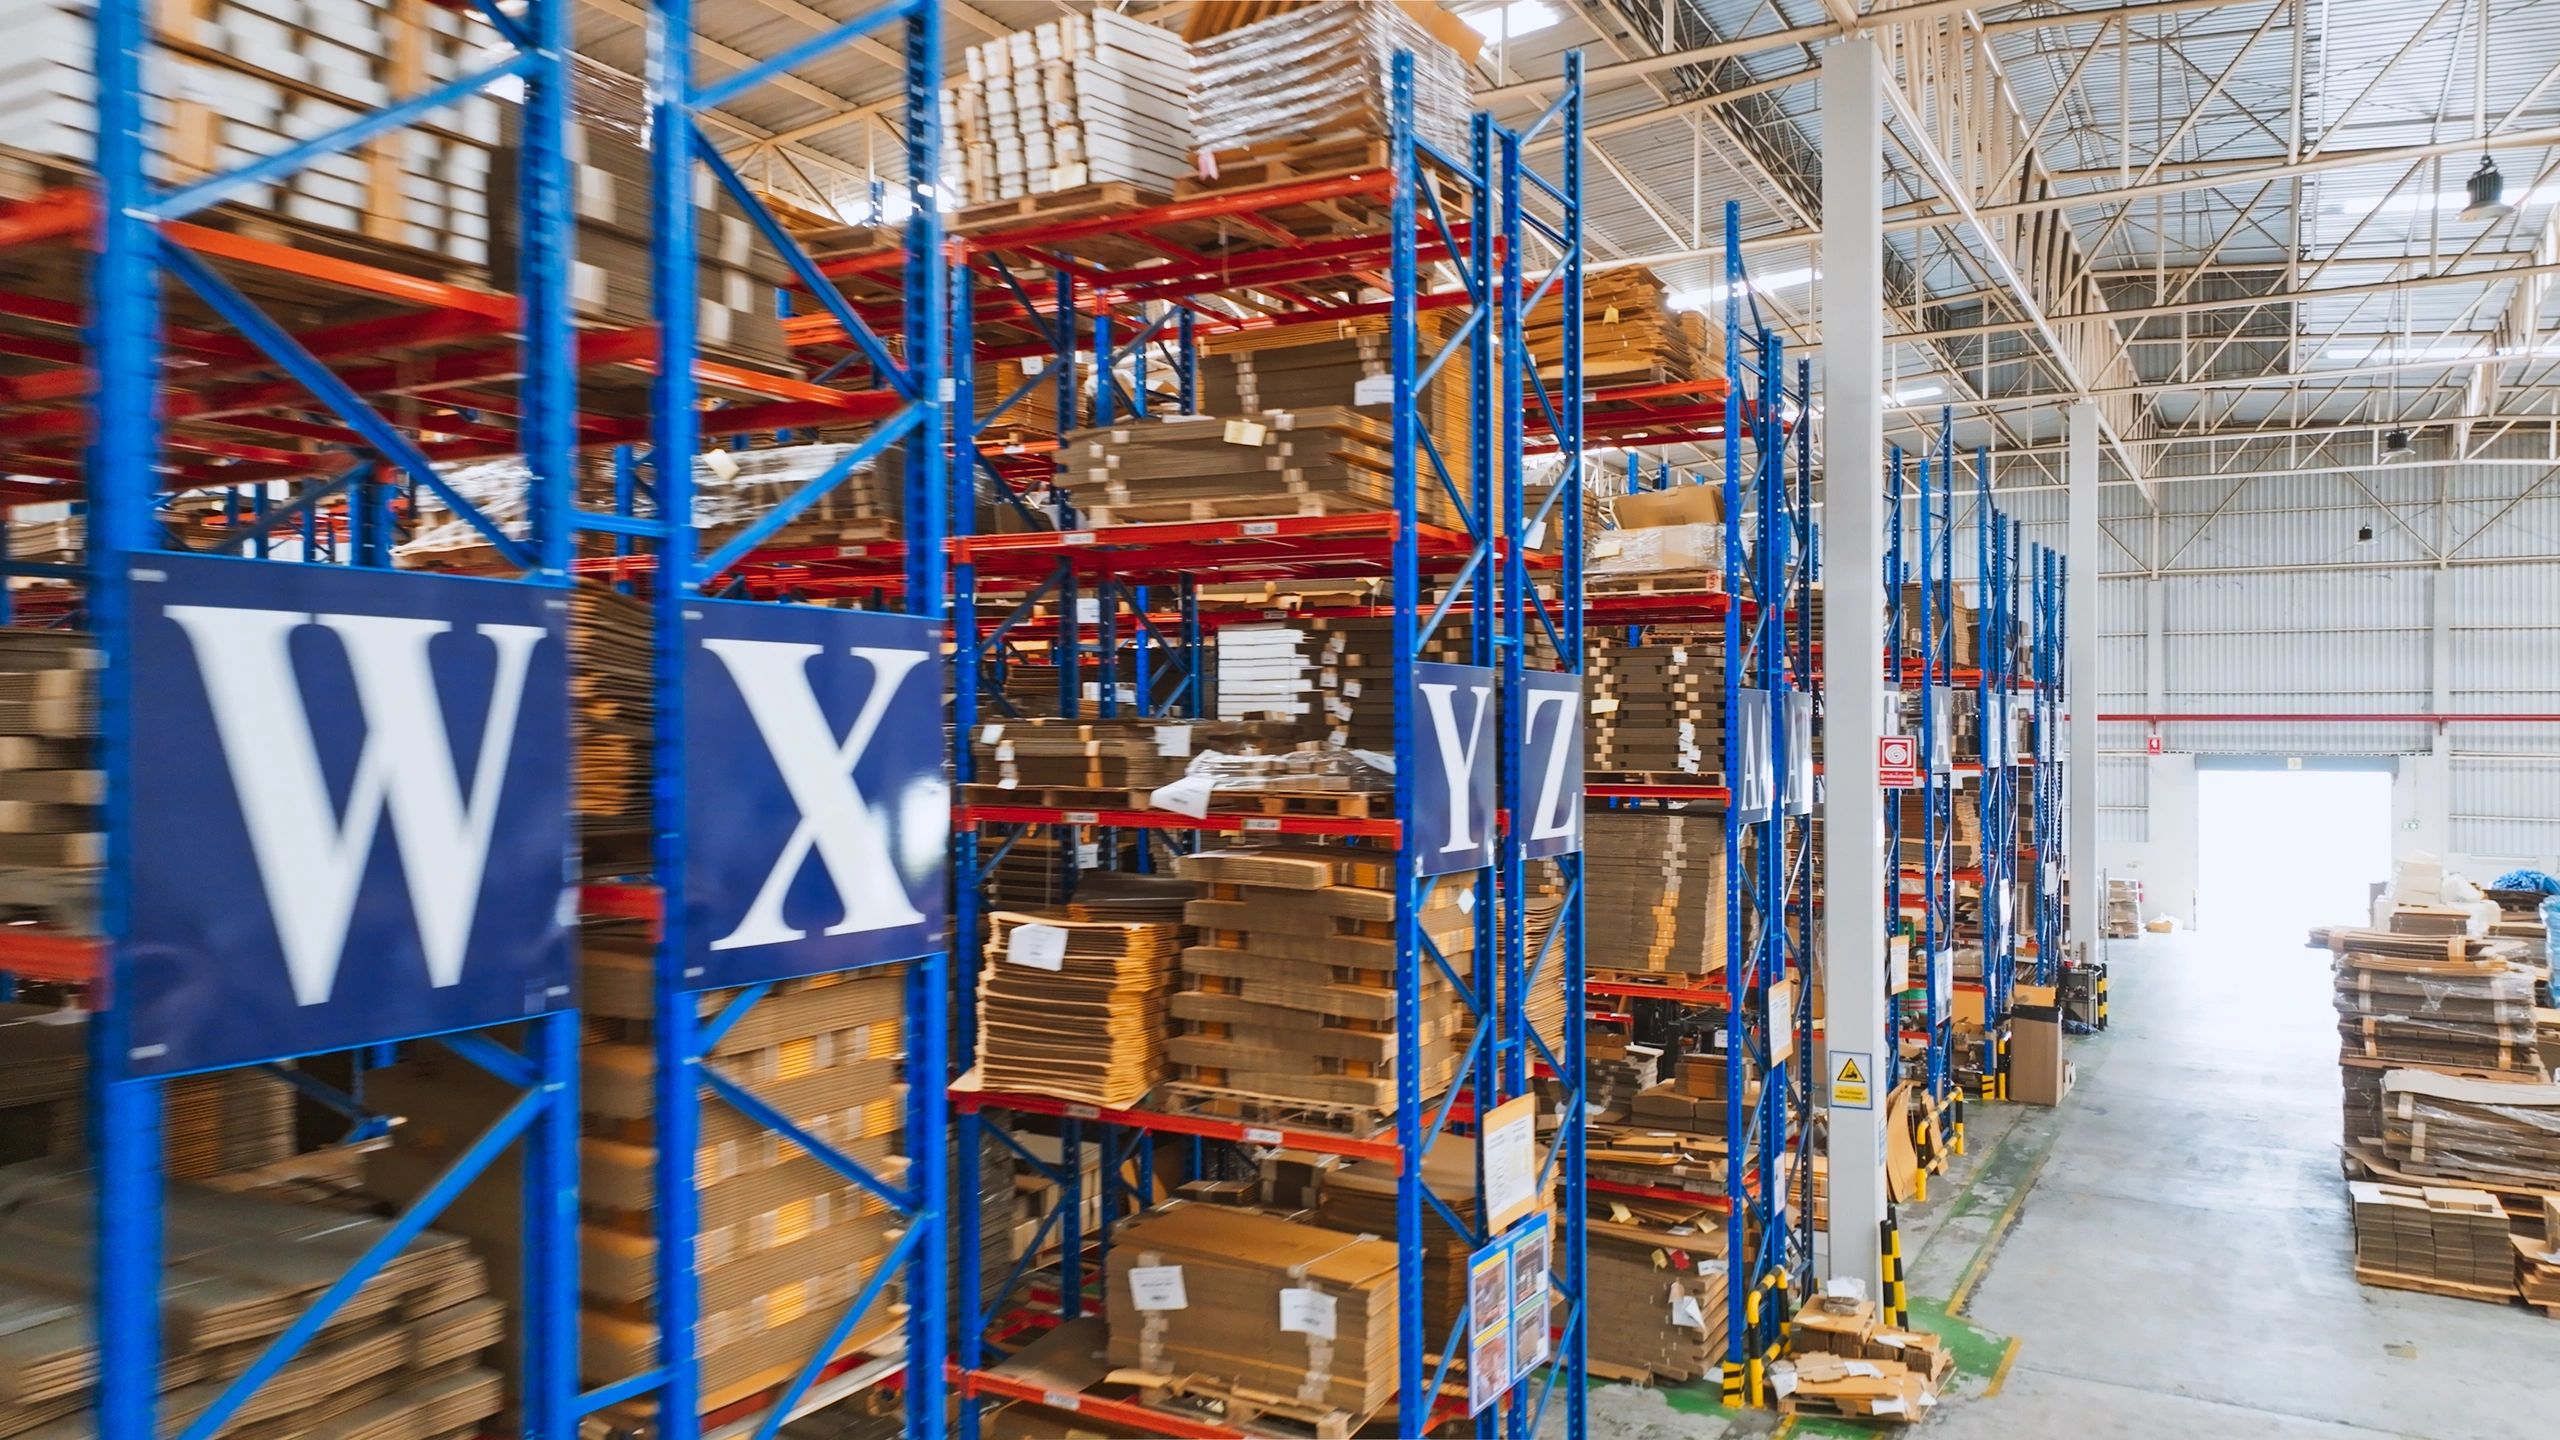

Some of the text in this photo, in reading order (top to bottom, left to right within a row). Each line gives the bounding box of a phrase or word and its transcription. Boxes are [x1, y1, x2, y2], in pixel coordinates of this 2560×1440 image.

[163, 605, 548, 1007] W
[701, 637, 931, 952] X
[1419, 683, 1491, 854] Y
[1525, 688, 1579, 841] Z
